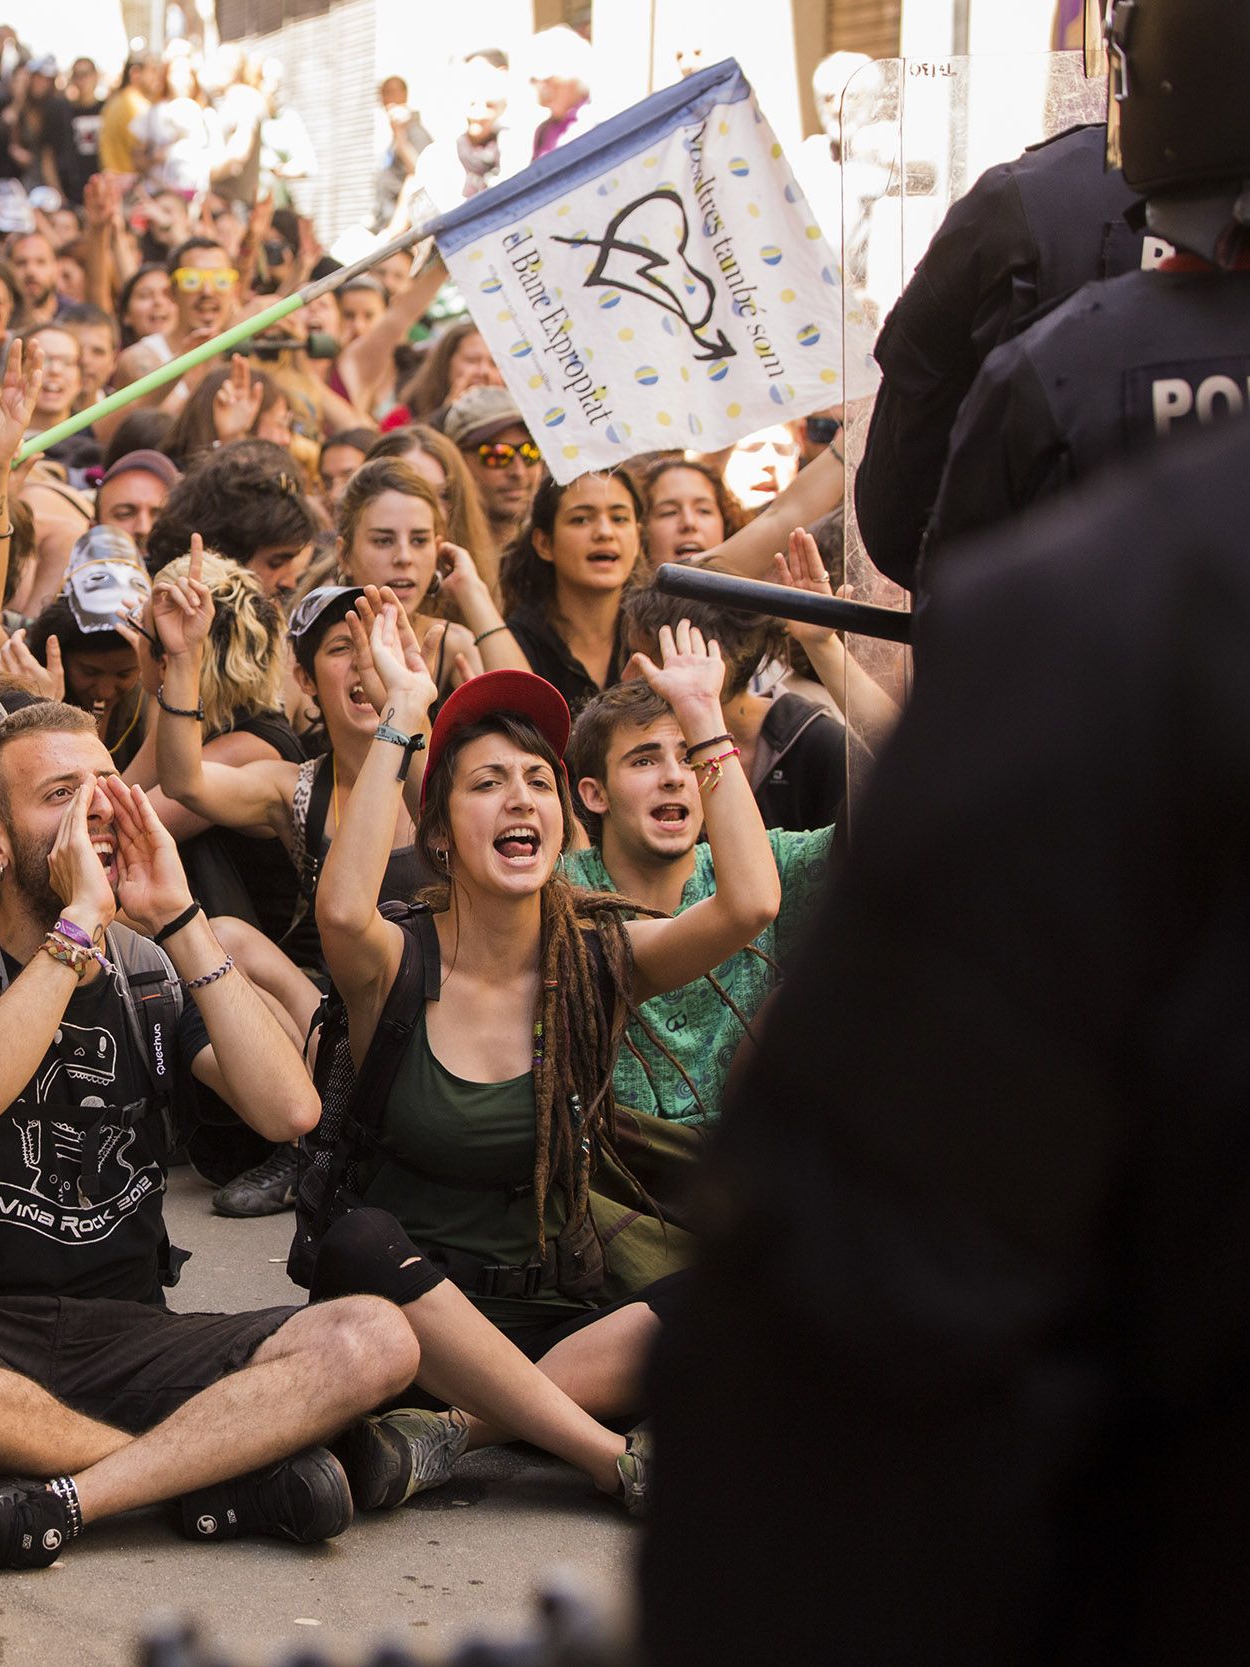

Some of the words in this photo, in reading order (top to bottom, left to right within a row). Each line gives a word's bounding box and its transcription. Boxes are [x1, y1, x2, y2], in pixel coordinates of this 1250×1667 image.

[502, 231, 533, 254] el
[685, 119, 724, 237] Nosaltres
[712, 236, 766, 318] també
[747, 323, 784, 377] som
[511, 248, 551, 311] Banc
[539, 306, 613, 426] Expropiat
[153, 1023, 166, 1076] Quechua
